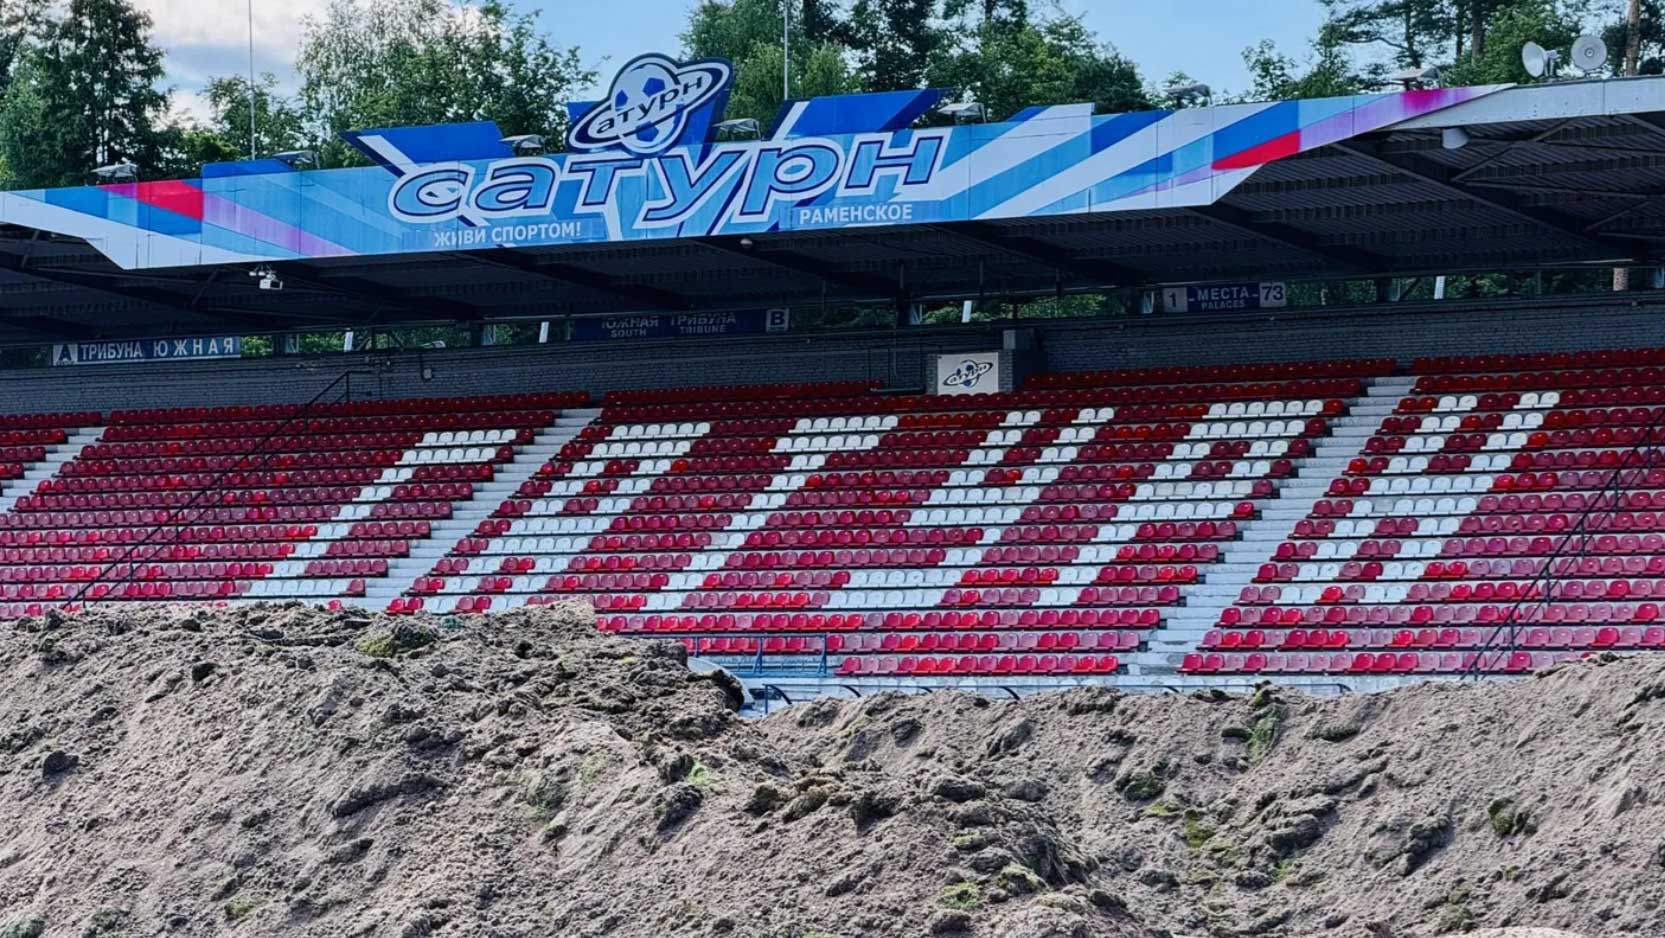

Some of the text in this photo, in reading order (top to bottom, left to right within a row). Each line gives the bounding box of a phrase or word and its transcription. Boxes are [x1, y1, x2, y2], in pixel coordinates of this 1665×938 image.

[799, 204, 913, 225] РАМЕНСКОЕ
[434, 221, 582, 247] ЖИВИ СПОРТОМ!
[1168, 291, 1177, 308] 1
[1261, 285, 1284, 302] 73
[610, 324, 728, 338] SOUTH TRIBUNE
[80, 341, 143, 361] ТРИБУНА
[153, 337, 234, 358] ЮЖНАЯ
